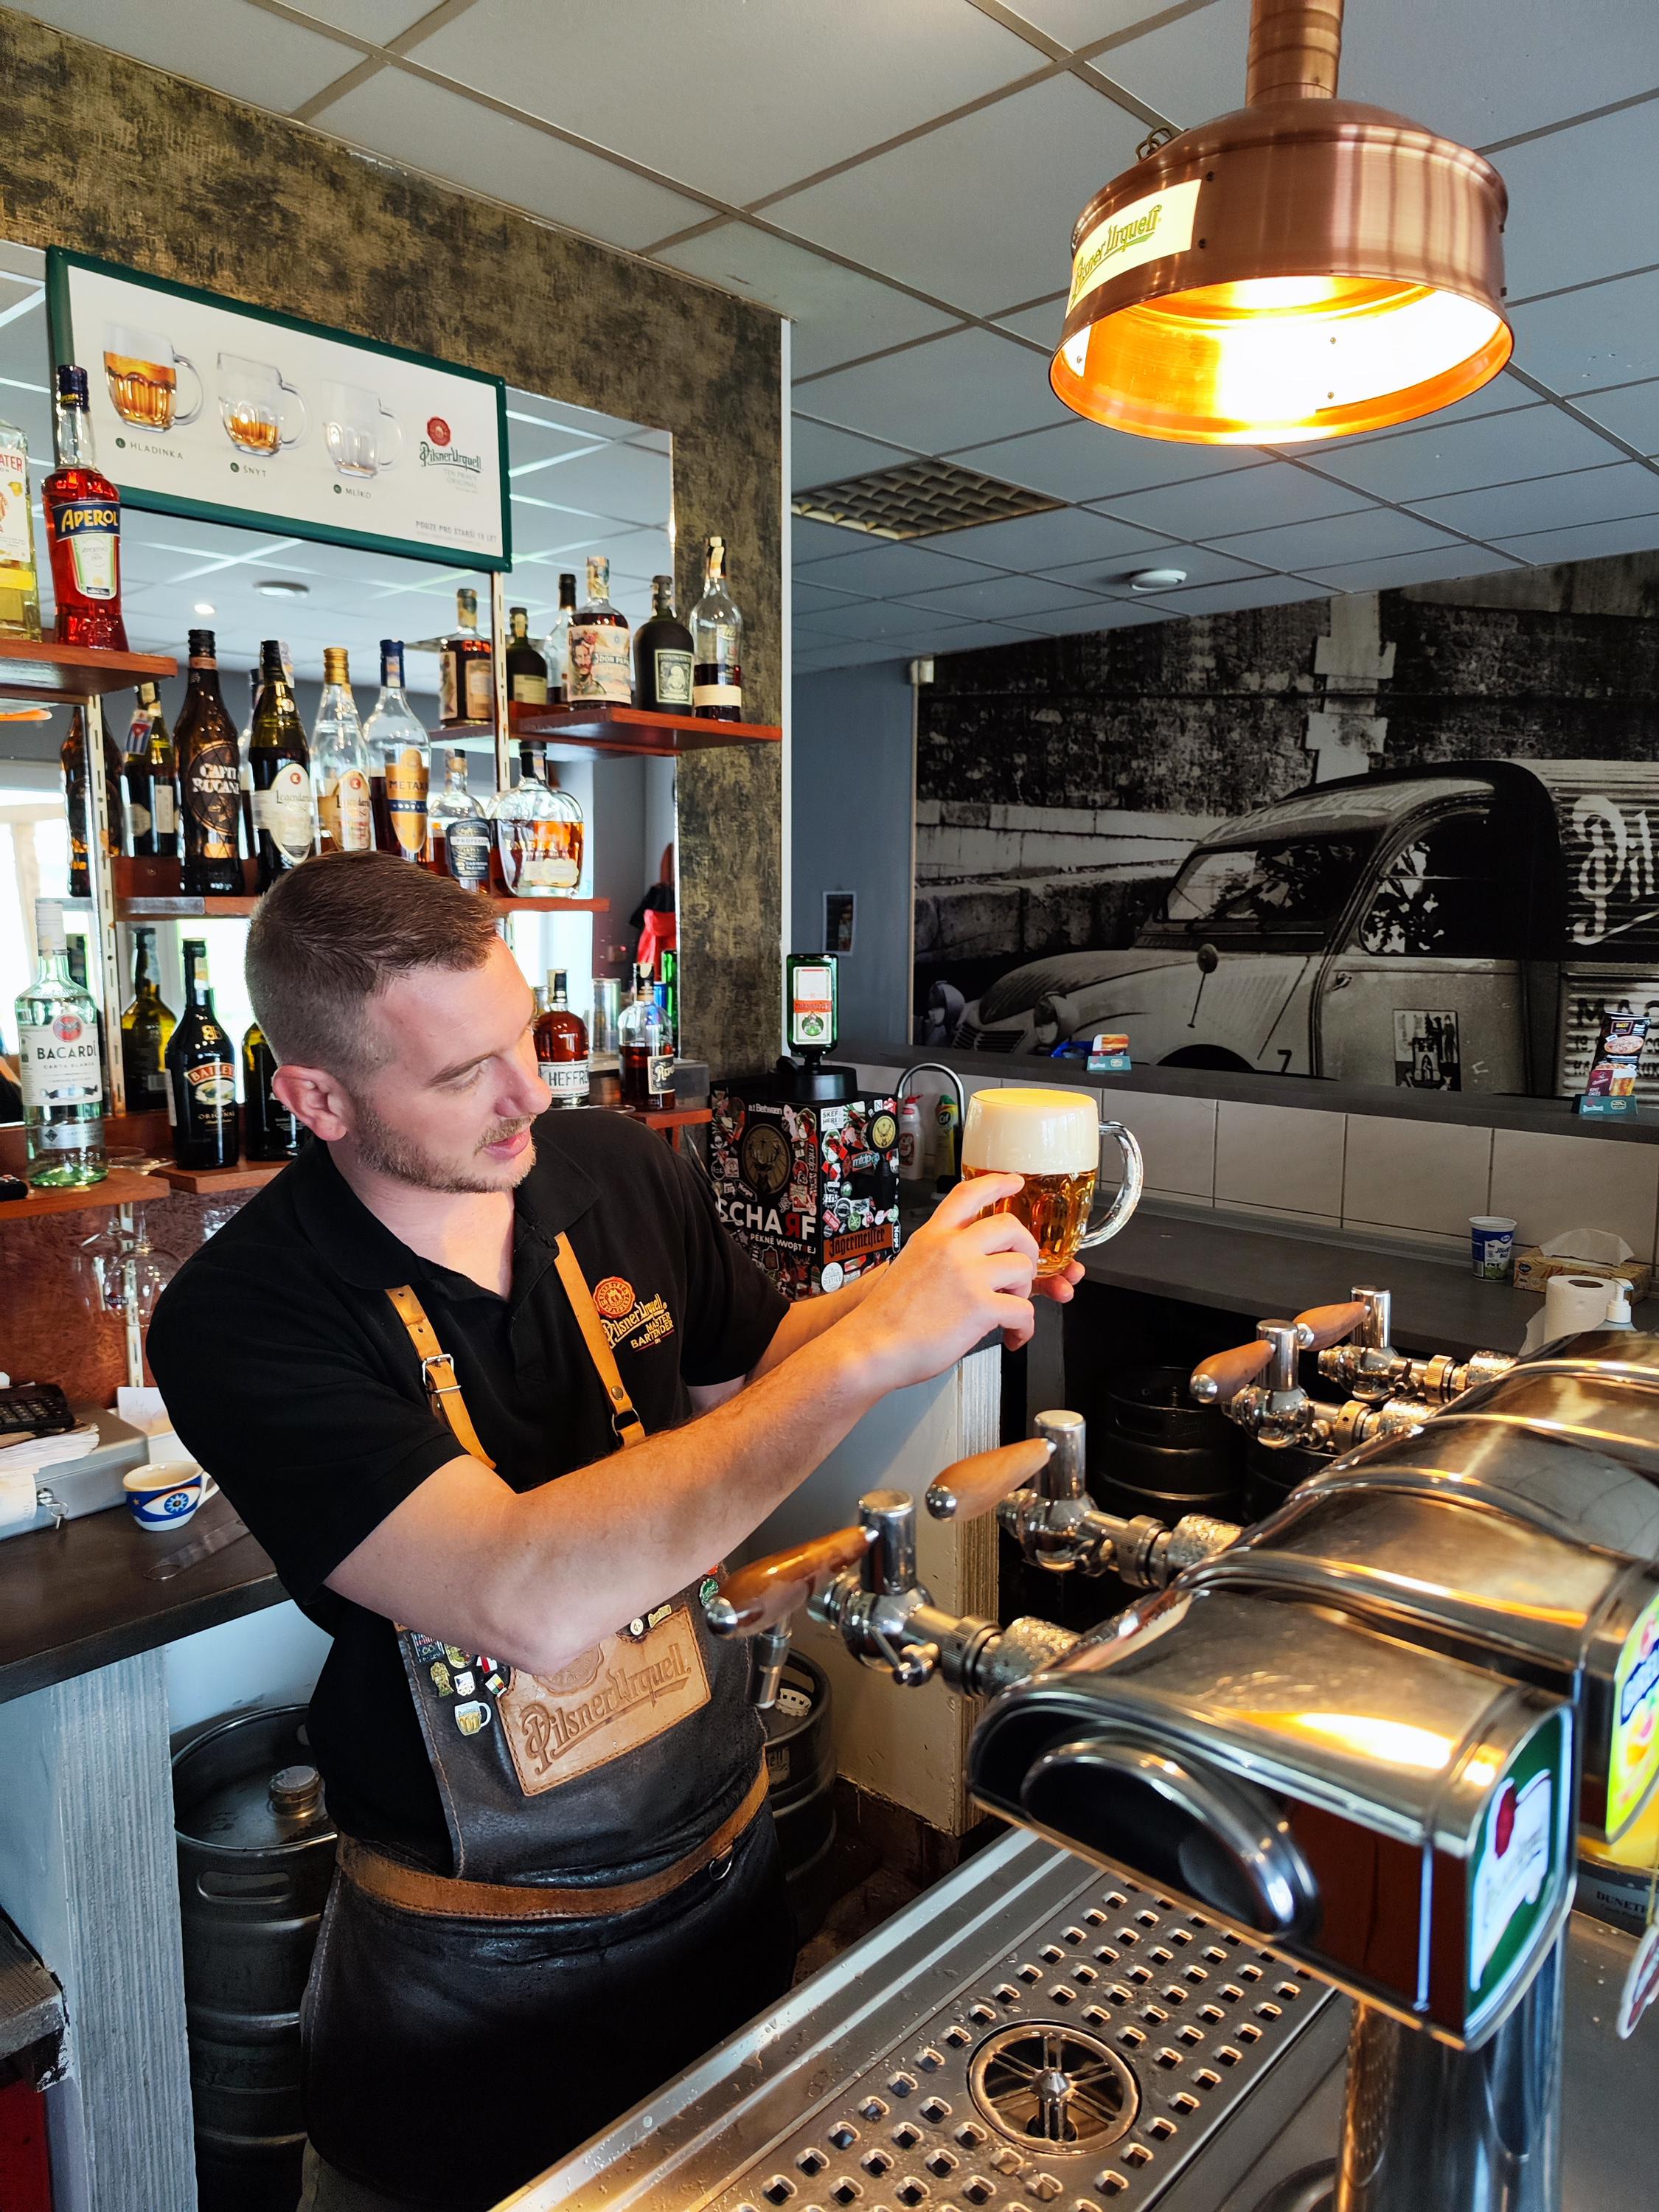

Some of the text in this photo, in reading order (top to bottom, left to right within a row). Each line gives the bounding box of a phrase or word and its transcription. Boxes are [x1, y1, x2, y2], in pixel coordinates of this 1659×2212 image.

[1104, 204, 1162, 253] Urquell
[130, 442, 183, 460] HLADINKA
[419, 441, 482, 471] Pilsner Urquell
[243, 465, 267, 477] ŠNYT
[345, 487, 371, 499] MLÍKO
[62, 509, 118, 532] APEROL
[415, 521, 437, 531] POUZE
[439, 525, 452, 534] PRO
[487, 535, 497, 543] LET
[37, 1040, 97, 1060] BACARDÍ
[635, 1293, 665, 1320] Urquell
[645, 1311, 672, 1334] MASTER
[630, 1320, 674, 1349] BARTENDER
[519, 1643, 686, 1775] Pilsner Urquell
